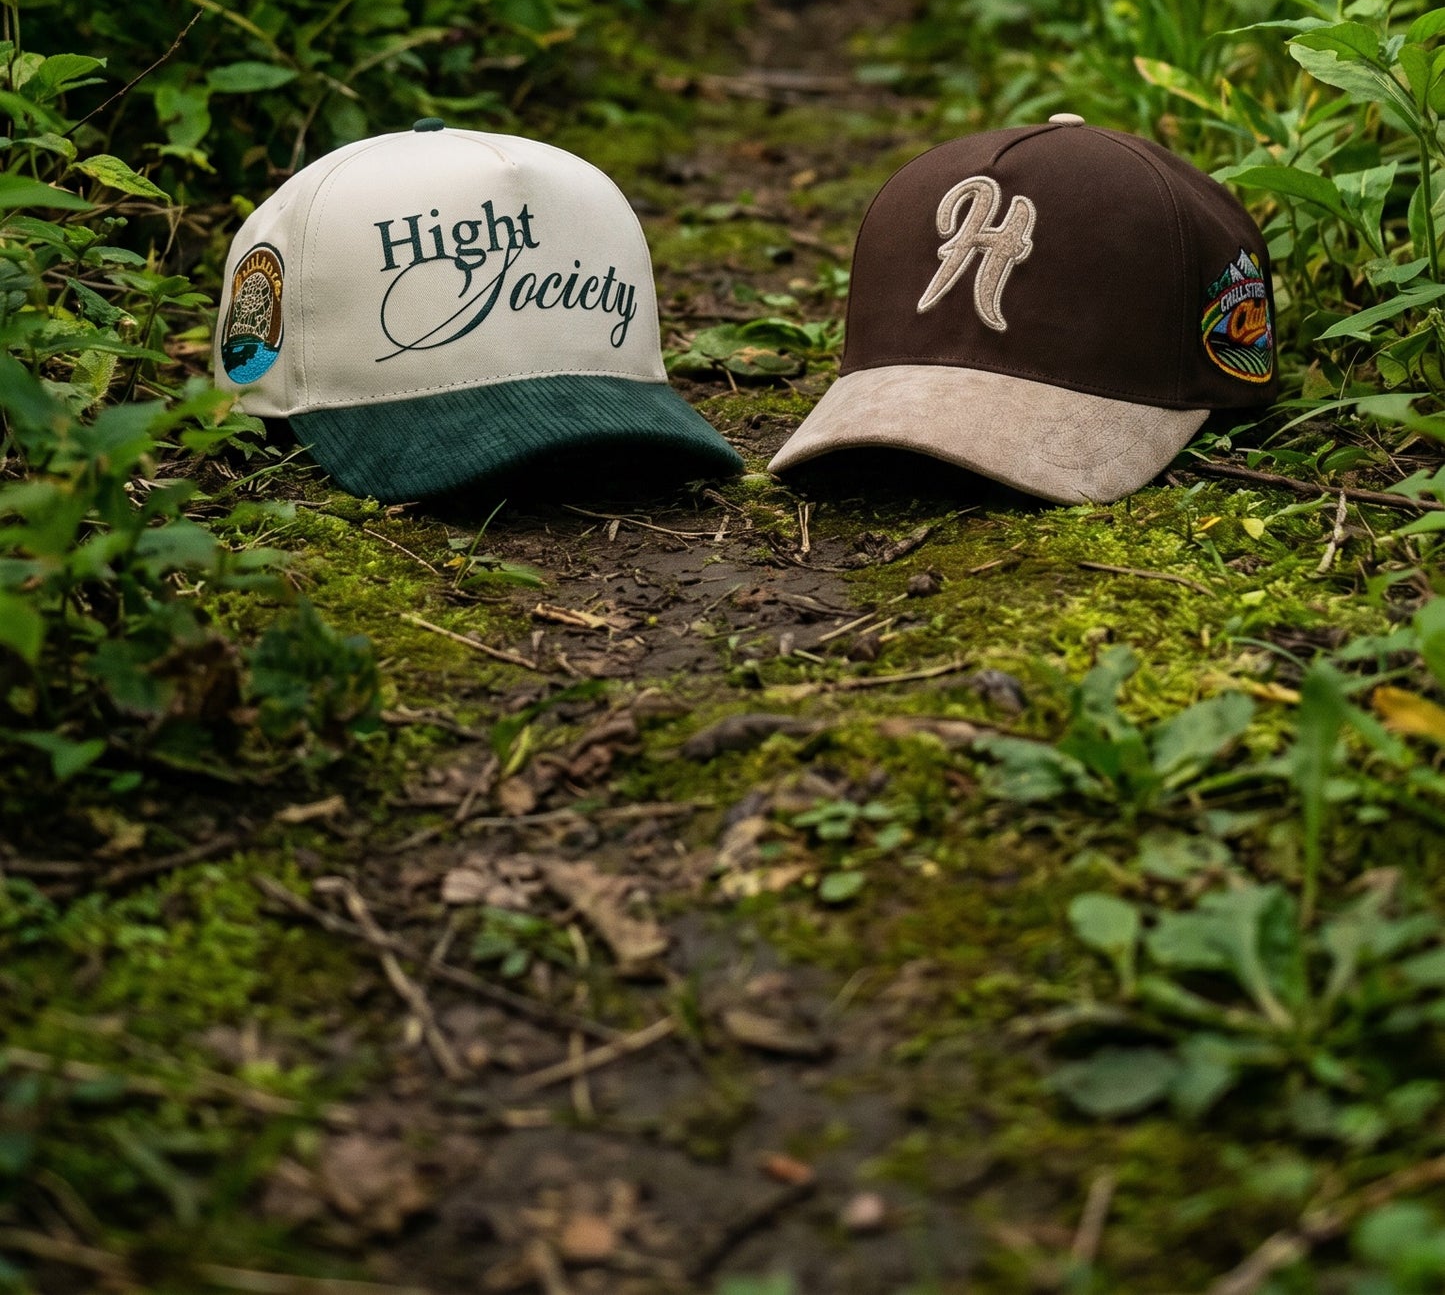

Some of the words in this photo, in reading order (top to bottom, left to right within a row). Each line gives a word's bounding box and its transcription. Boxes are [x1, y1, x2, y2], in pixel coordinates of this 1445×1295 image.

[374, 200, 540, 298] Hight
[375, 229, 638, 362] Society
[916, 175, 1037, 333] H
